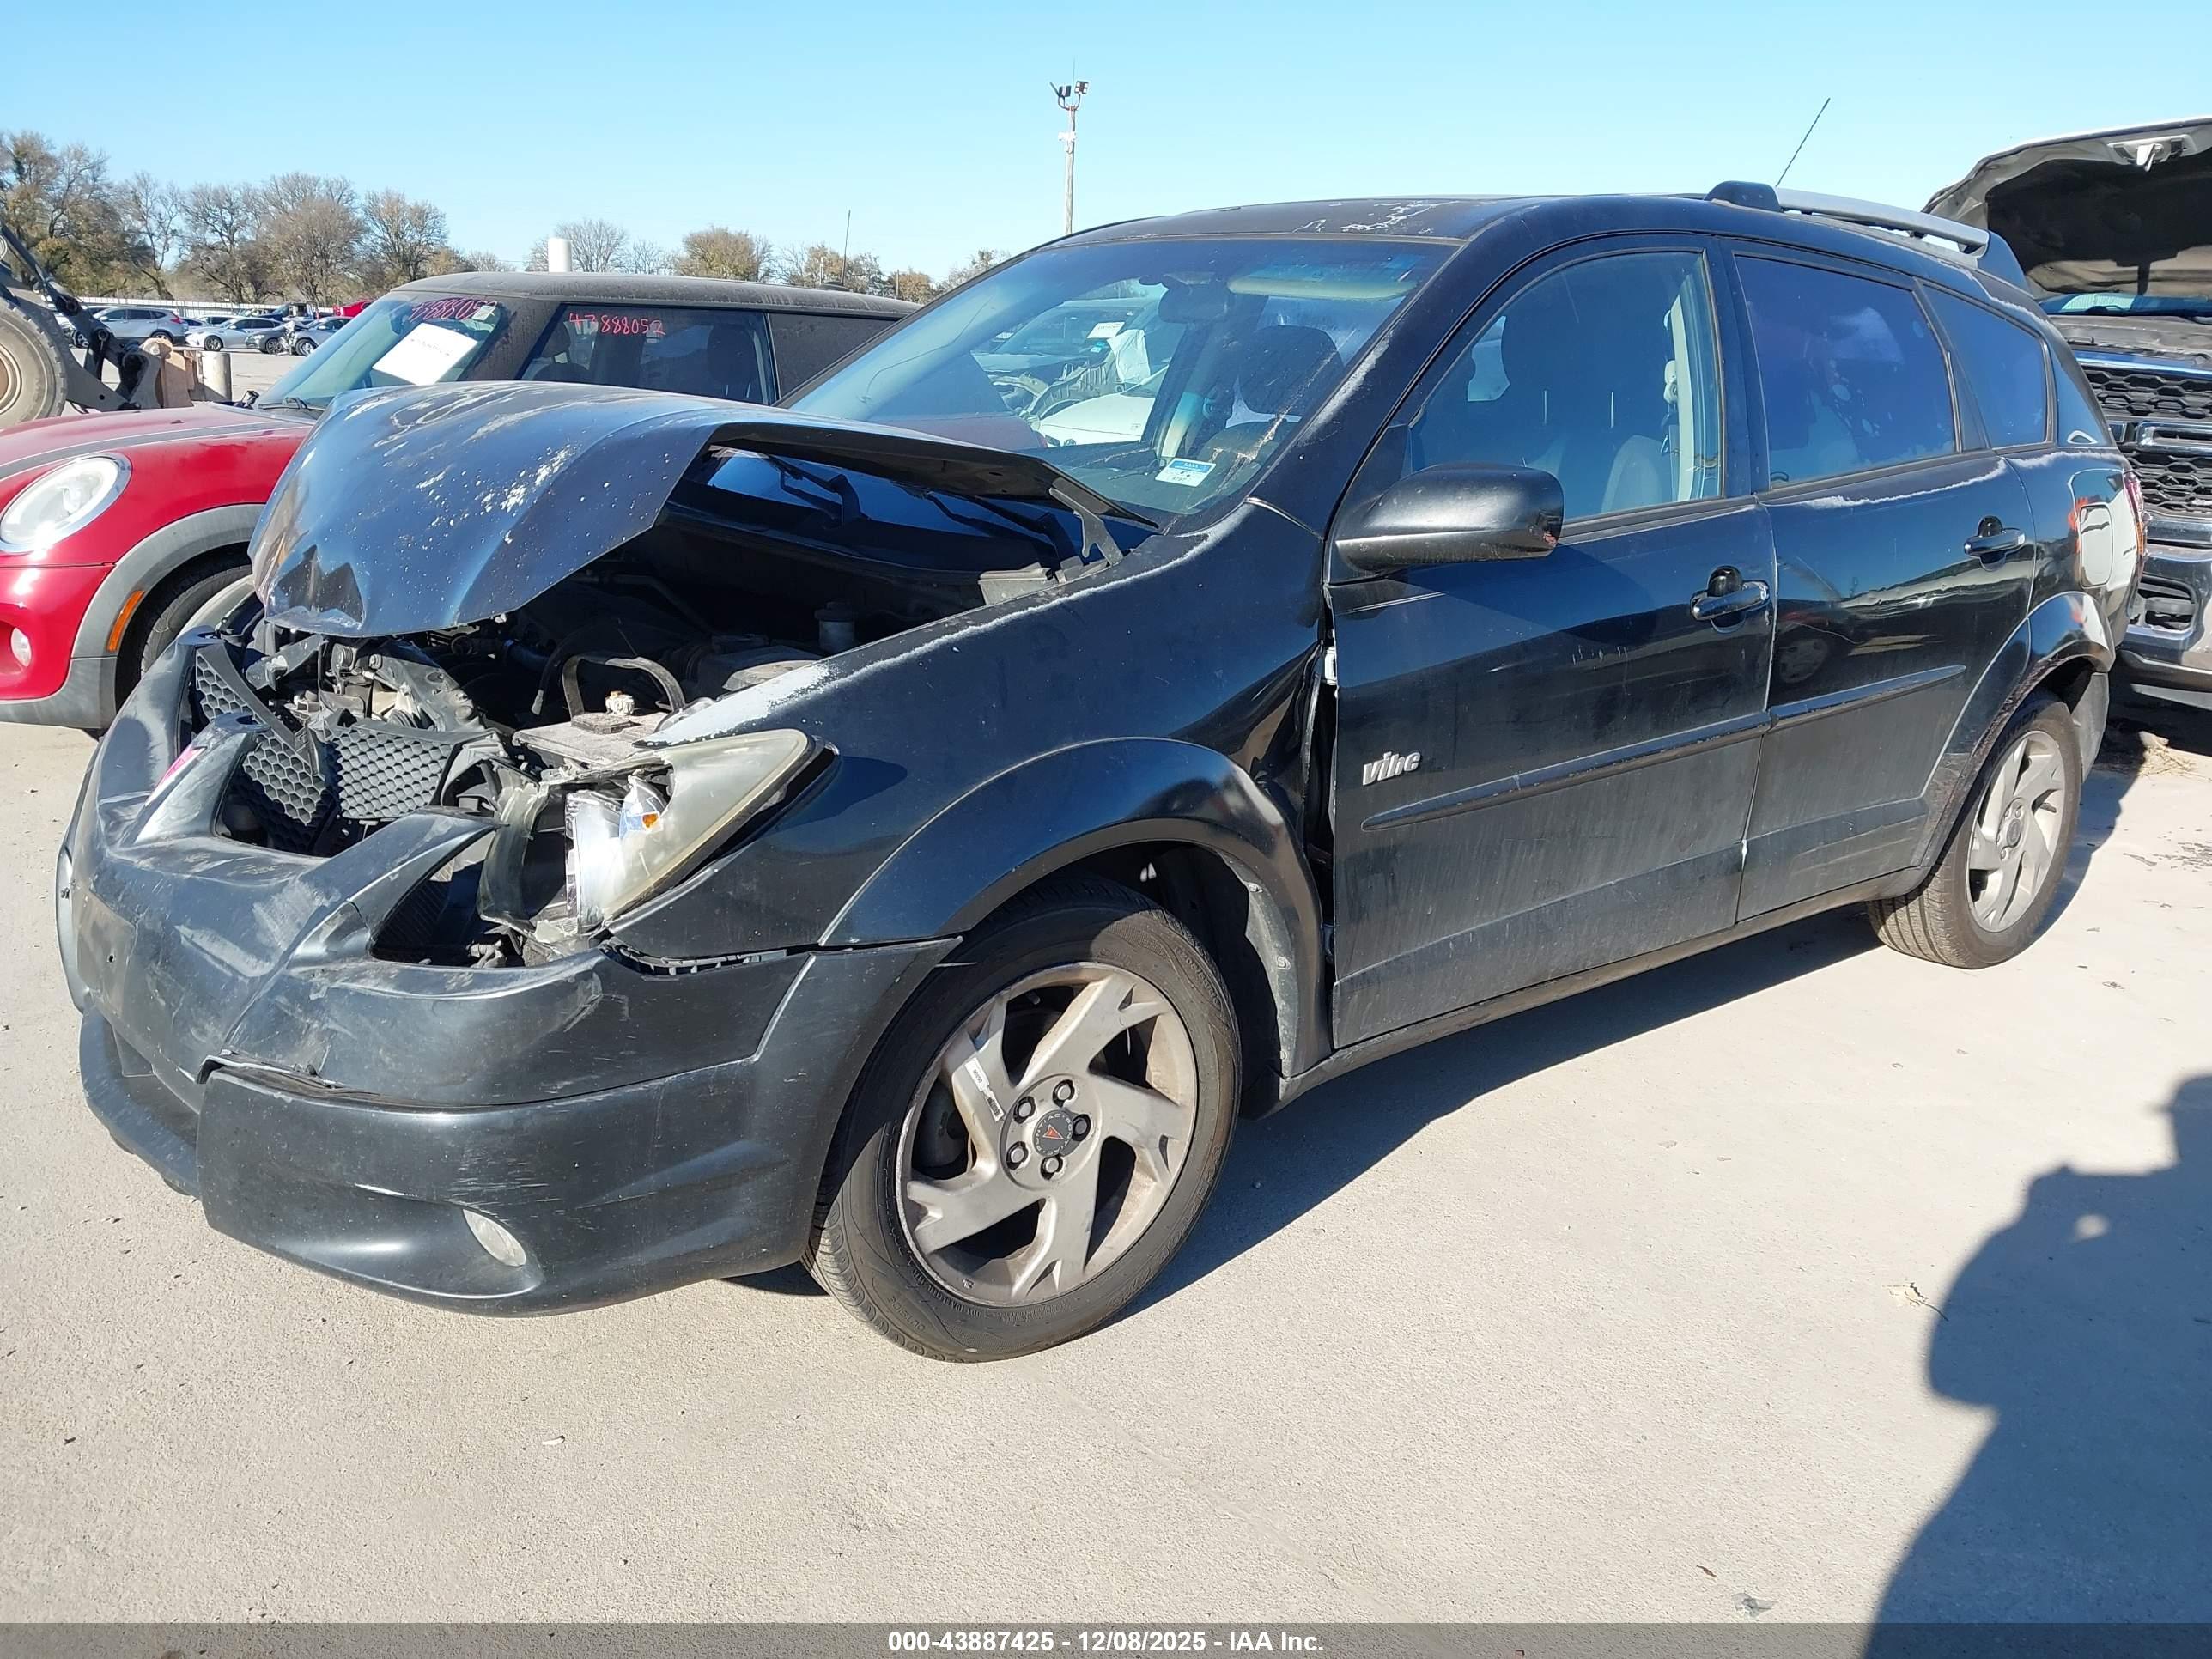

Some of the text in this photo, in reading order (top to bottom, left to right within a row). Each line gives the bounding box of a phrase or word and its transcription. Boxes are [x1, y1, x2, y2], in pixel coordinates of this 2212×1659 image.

[568, 313, 666, 336] 43888052
[1035, 1113, 1061, 1151] PONTIAC
[886, 1294, 927, 1334] OUTSIDE
